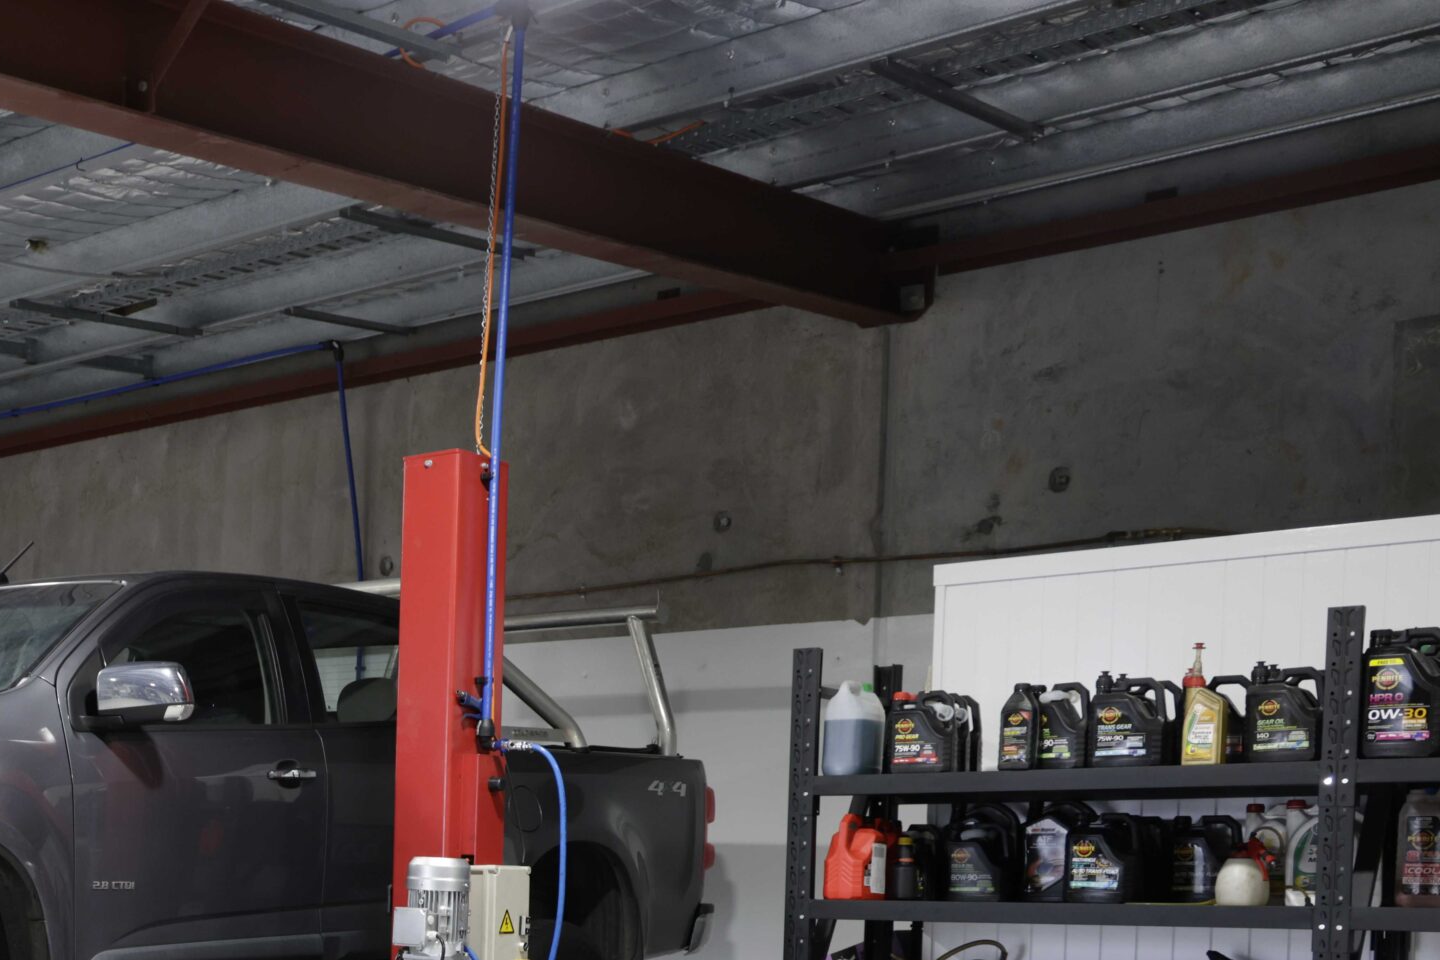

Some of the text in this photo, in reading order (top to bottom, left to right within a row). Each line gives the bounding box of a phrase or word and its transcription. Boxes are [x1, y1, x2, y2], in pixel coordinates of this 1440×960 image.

[1369, 693, 1393, 703] HPR
[1367, 707, 1427, 721] 0W-30
[895, 744, 920, 752] 75W-90
